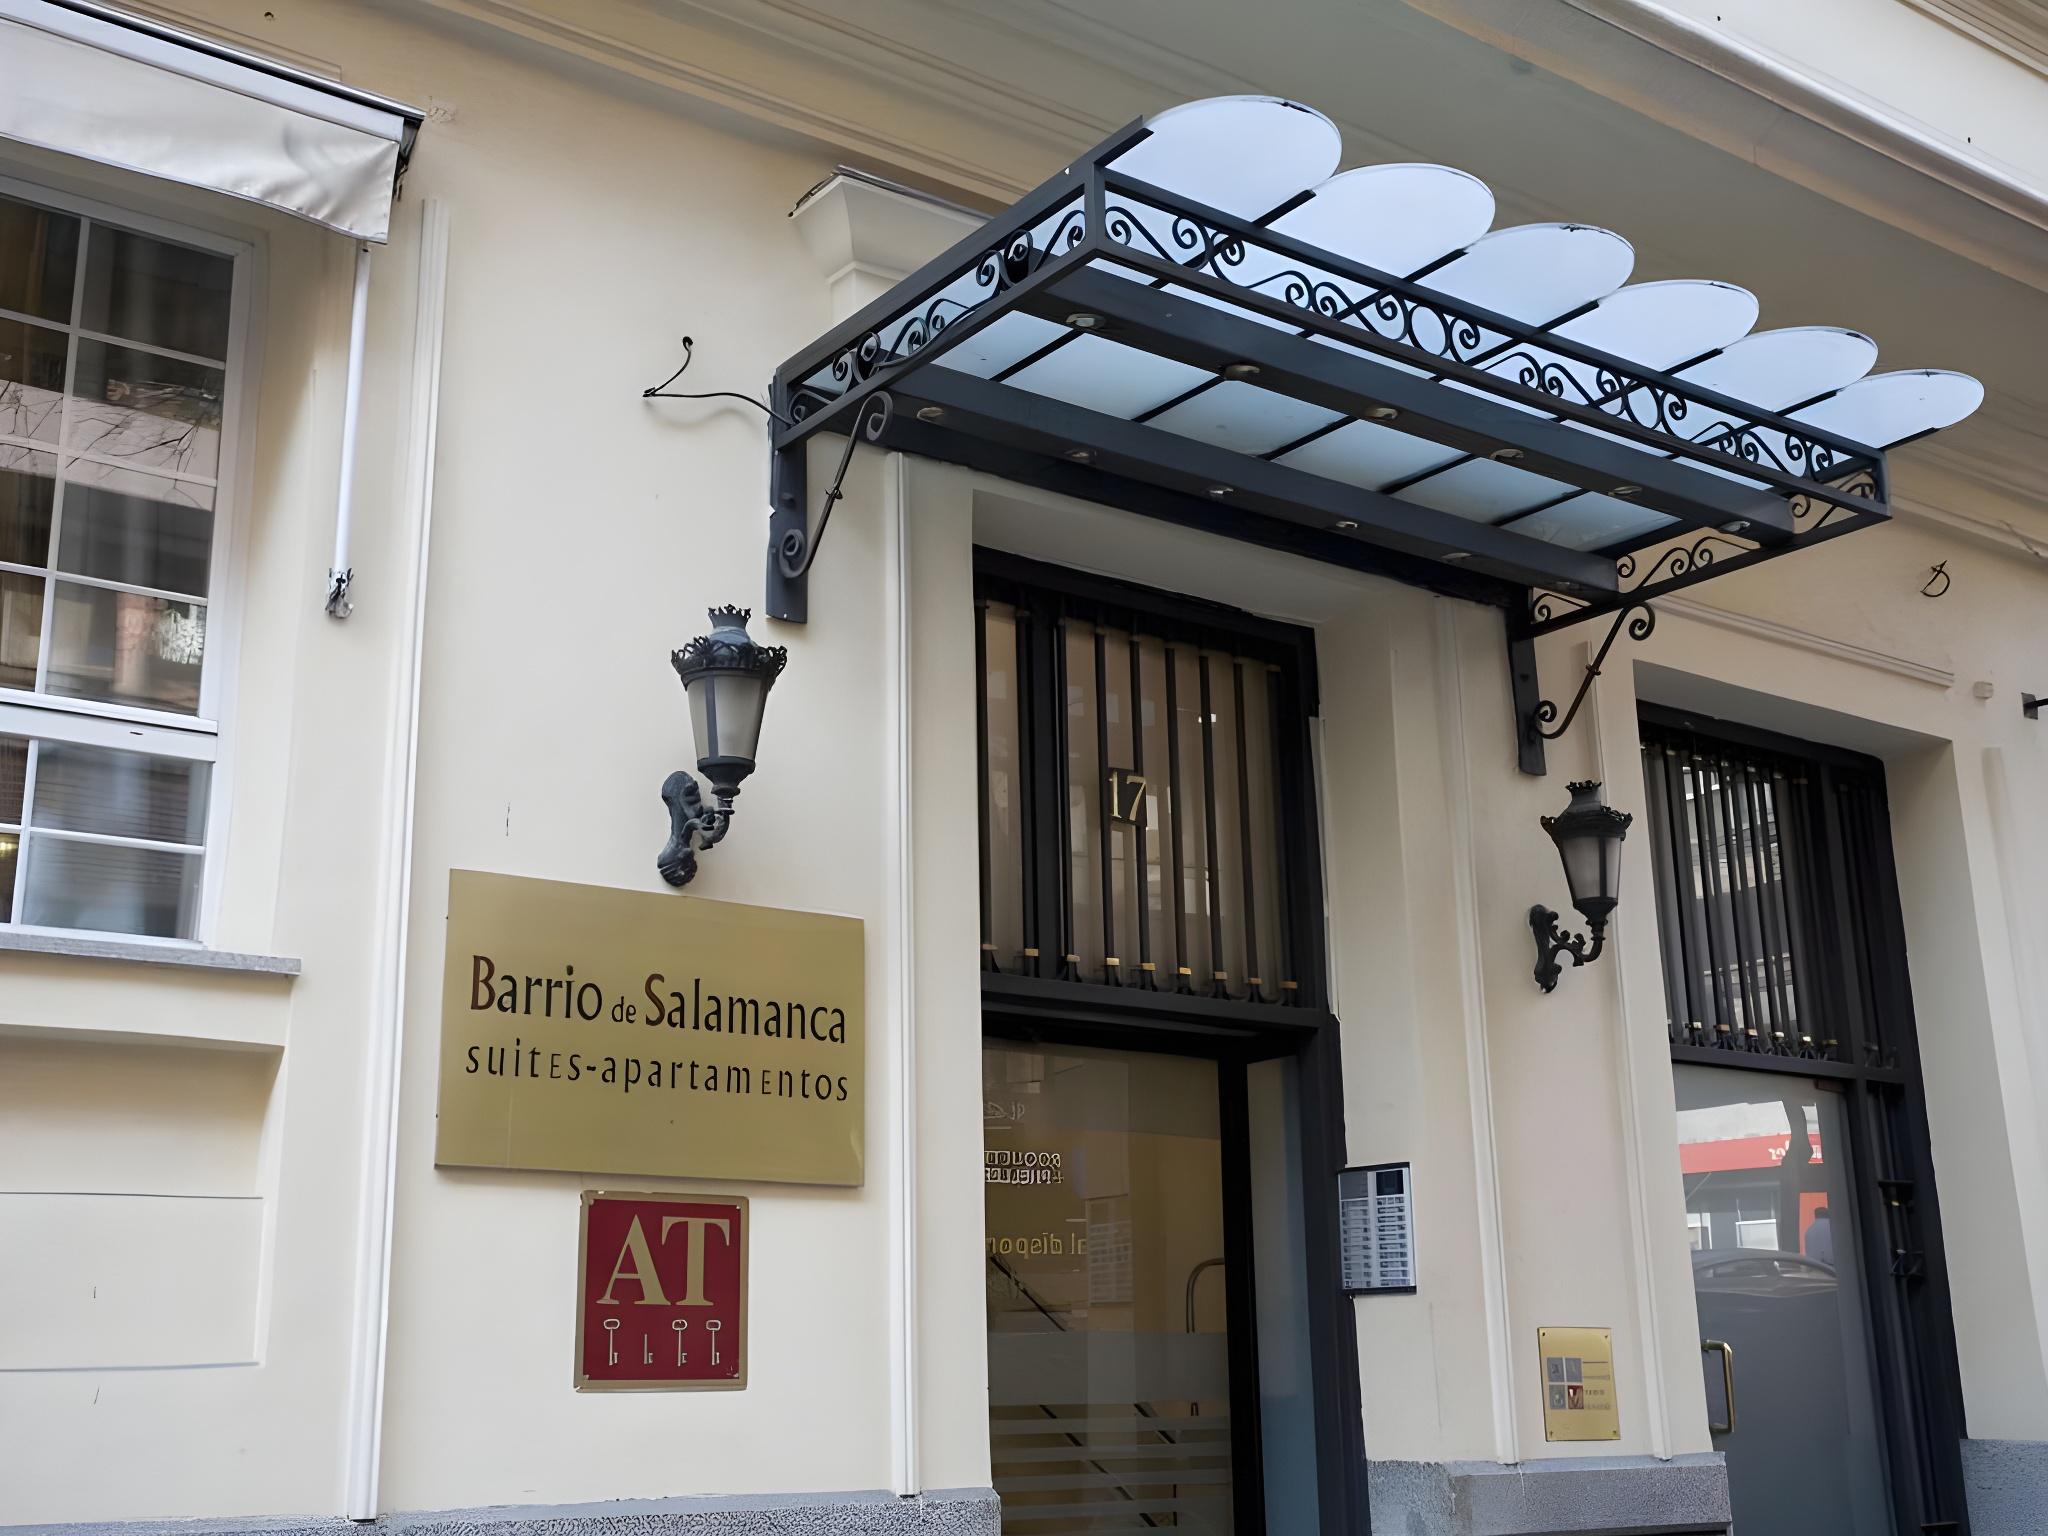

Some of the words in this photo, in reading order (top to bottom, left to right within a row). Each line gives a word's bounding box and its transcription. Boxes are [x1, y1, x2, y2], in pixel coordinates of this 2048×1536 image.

[1109, 771, 1146, 821] 17
[471, 954, 603, 1021] Barrio
[611, 996, 637, 1024] de
[644, 973, 846, 1044] Salamanca
[596, 1214, 731, 1306] AT
